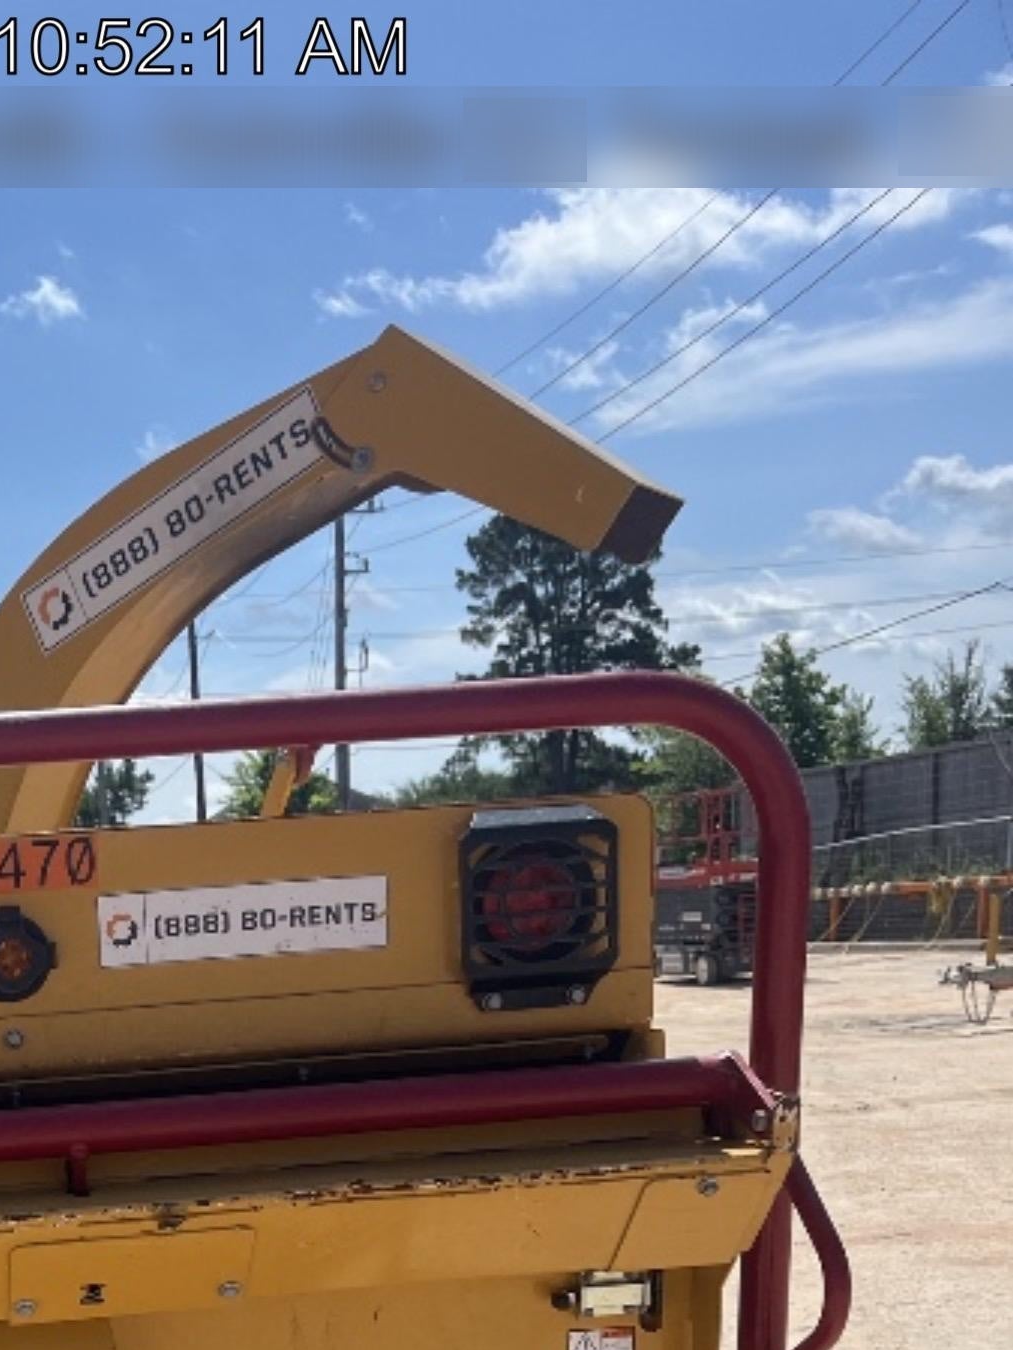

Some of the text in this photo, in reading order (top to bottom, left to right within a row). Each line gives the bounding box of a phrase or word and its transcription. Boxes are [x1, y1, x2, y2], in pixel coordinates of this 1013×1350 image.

[82, 418, 312, 598] (888) 80-RENTS
[154, 903, 377, 940] (888) 80-RENTS
